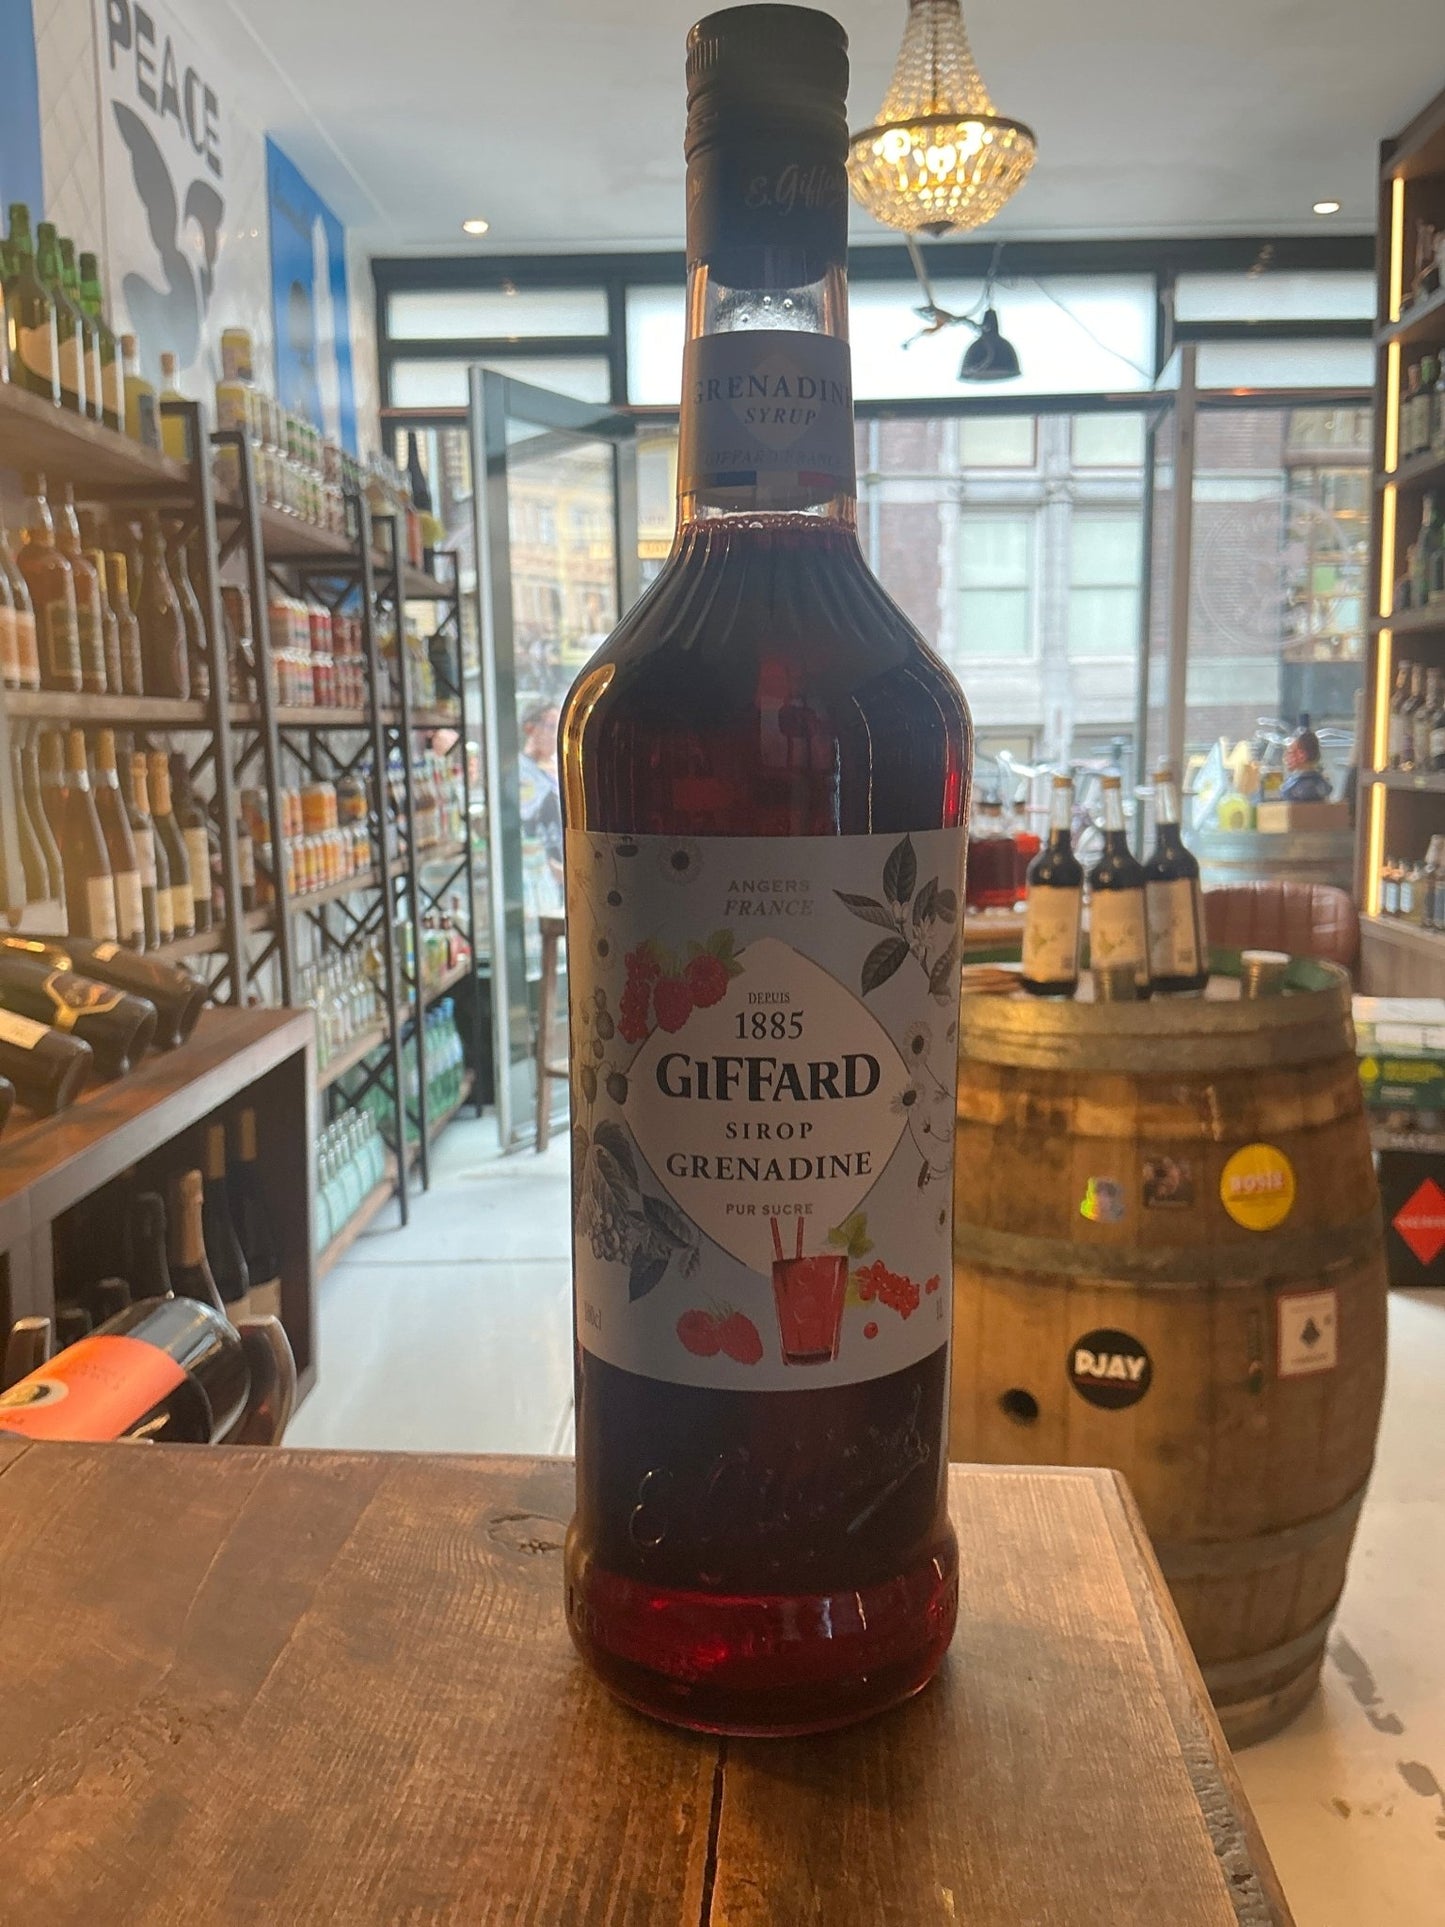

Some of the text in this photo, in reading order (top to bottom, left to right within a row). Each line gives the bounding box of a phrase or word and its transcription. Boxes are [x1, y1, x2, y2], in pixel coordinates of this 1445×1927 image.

[107, 0, 223, 179] PEACE
[745, 407, 816, 426] SYRUP
[727, 879, 810, 893] ANGERS
[724, 899, 815, 917] FRANCE
[748, 990, 791, 1005] DEPUIS
[735, 1010, 805, 1040] 1885
[724, 1120, 814, 1141] SIROP
[666, 1150, 873, 1182] GRENADINE
[725, 1202, 814, 1216] PUR SUCRE
